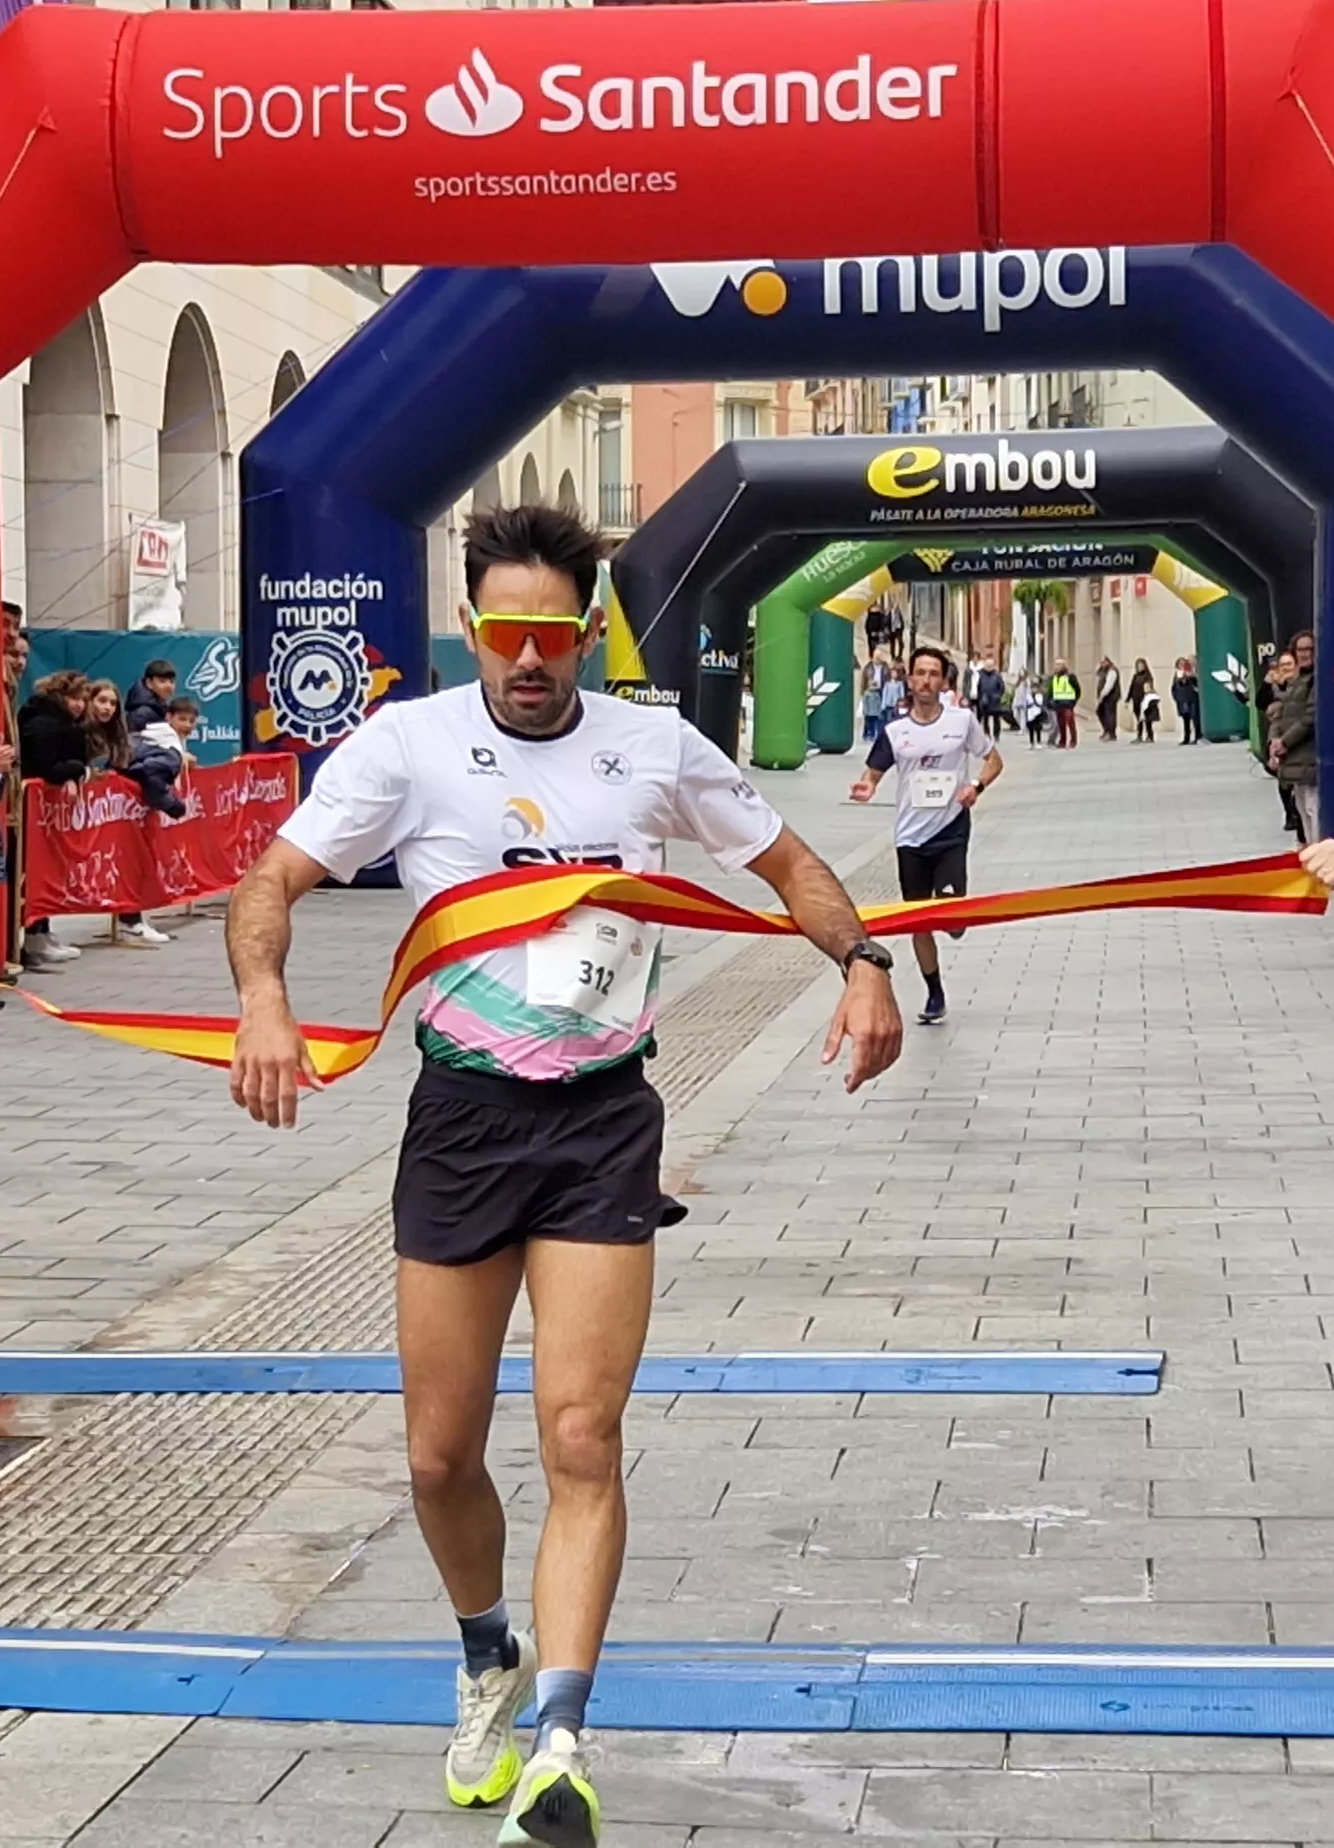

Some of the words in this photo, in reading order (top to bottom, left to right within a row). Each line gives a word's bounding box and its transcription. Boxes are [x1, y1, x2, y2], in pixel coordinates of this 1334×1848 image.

[162, 66, 409, 158] Sports
[538, 53, 958, 133] Santander
[413, 165, 679, 202] sportssantander.es
[867, 438, 1096, 498] embou
[950, 559, 989, 573] CAJA
[994, 557, 1043, 572] RURAL
[1048, 556, 1067, 570] DE
[260, 572, 383, 601] fundación
[276, 600, 357, 630] mupol
[577, 959, 616, 998] 312
